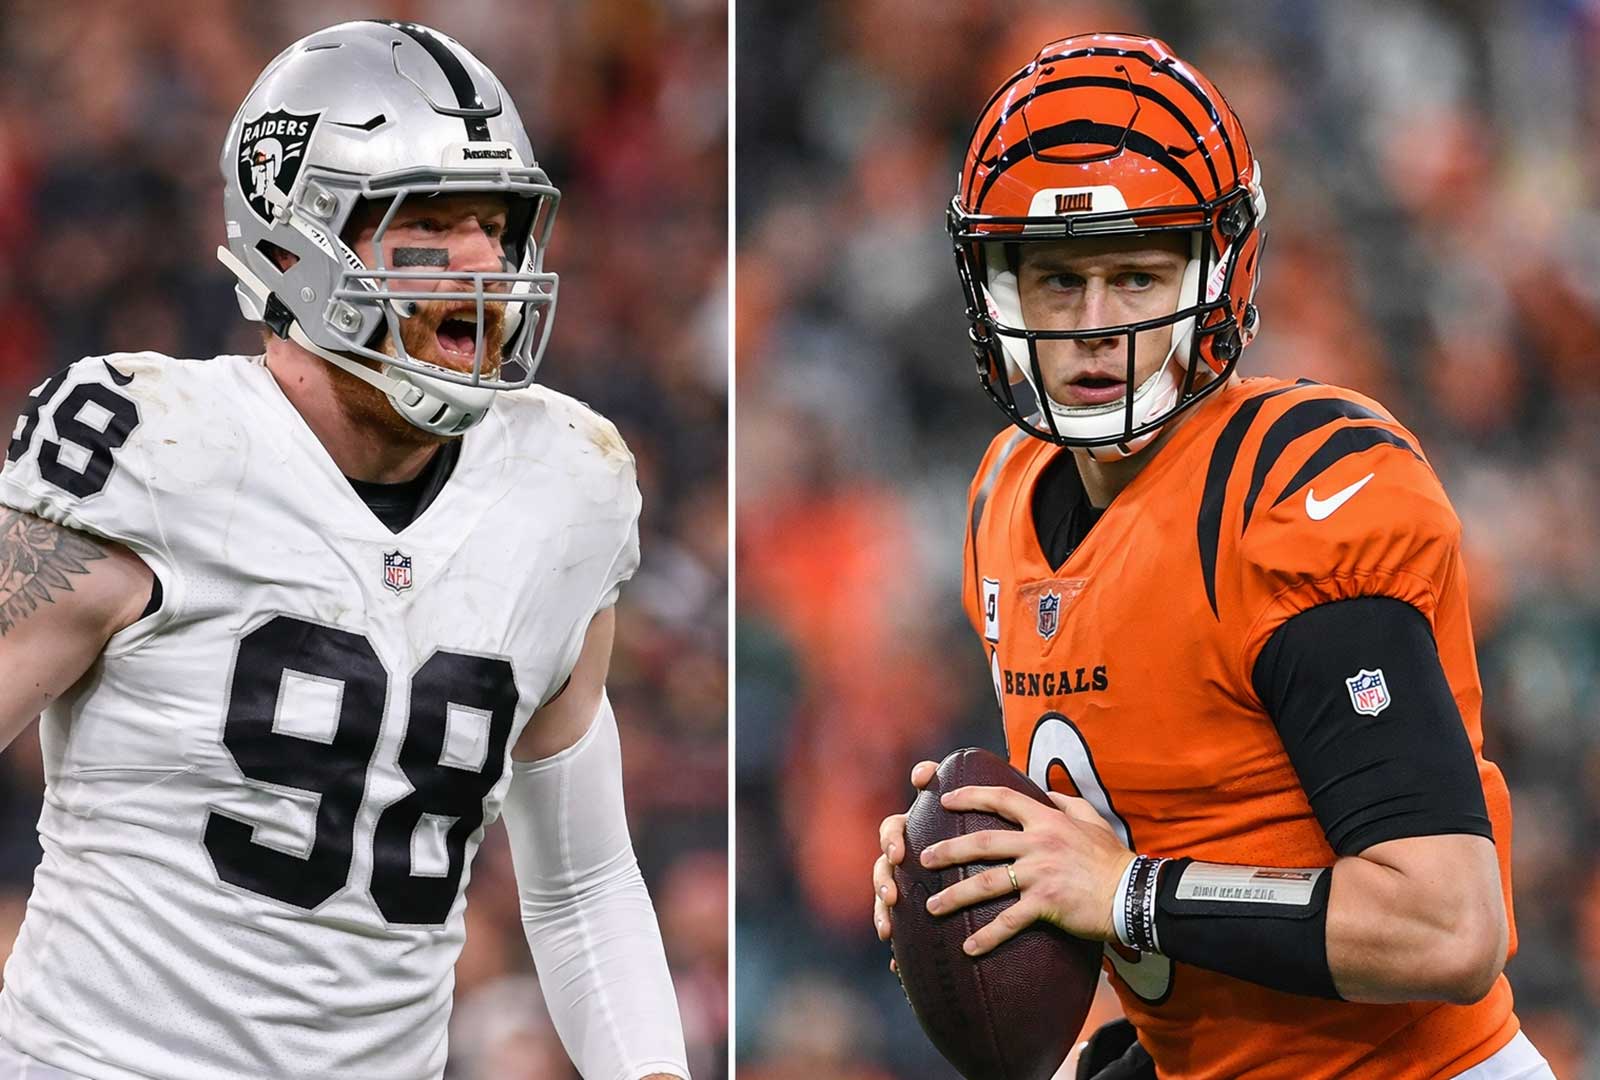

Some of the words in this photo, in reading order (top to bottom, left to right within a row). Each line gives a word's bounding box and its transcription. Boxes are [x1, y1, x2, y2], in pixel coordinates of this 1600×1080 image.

[242, 119, 309, 144] RAIDERS
[387, 567, 410, 586] NFL
[1003, 665, 1109, 697] BENGALS
[1357, 688, 1385, 708] NFL
[203, 611, 520, 929] 98
